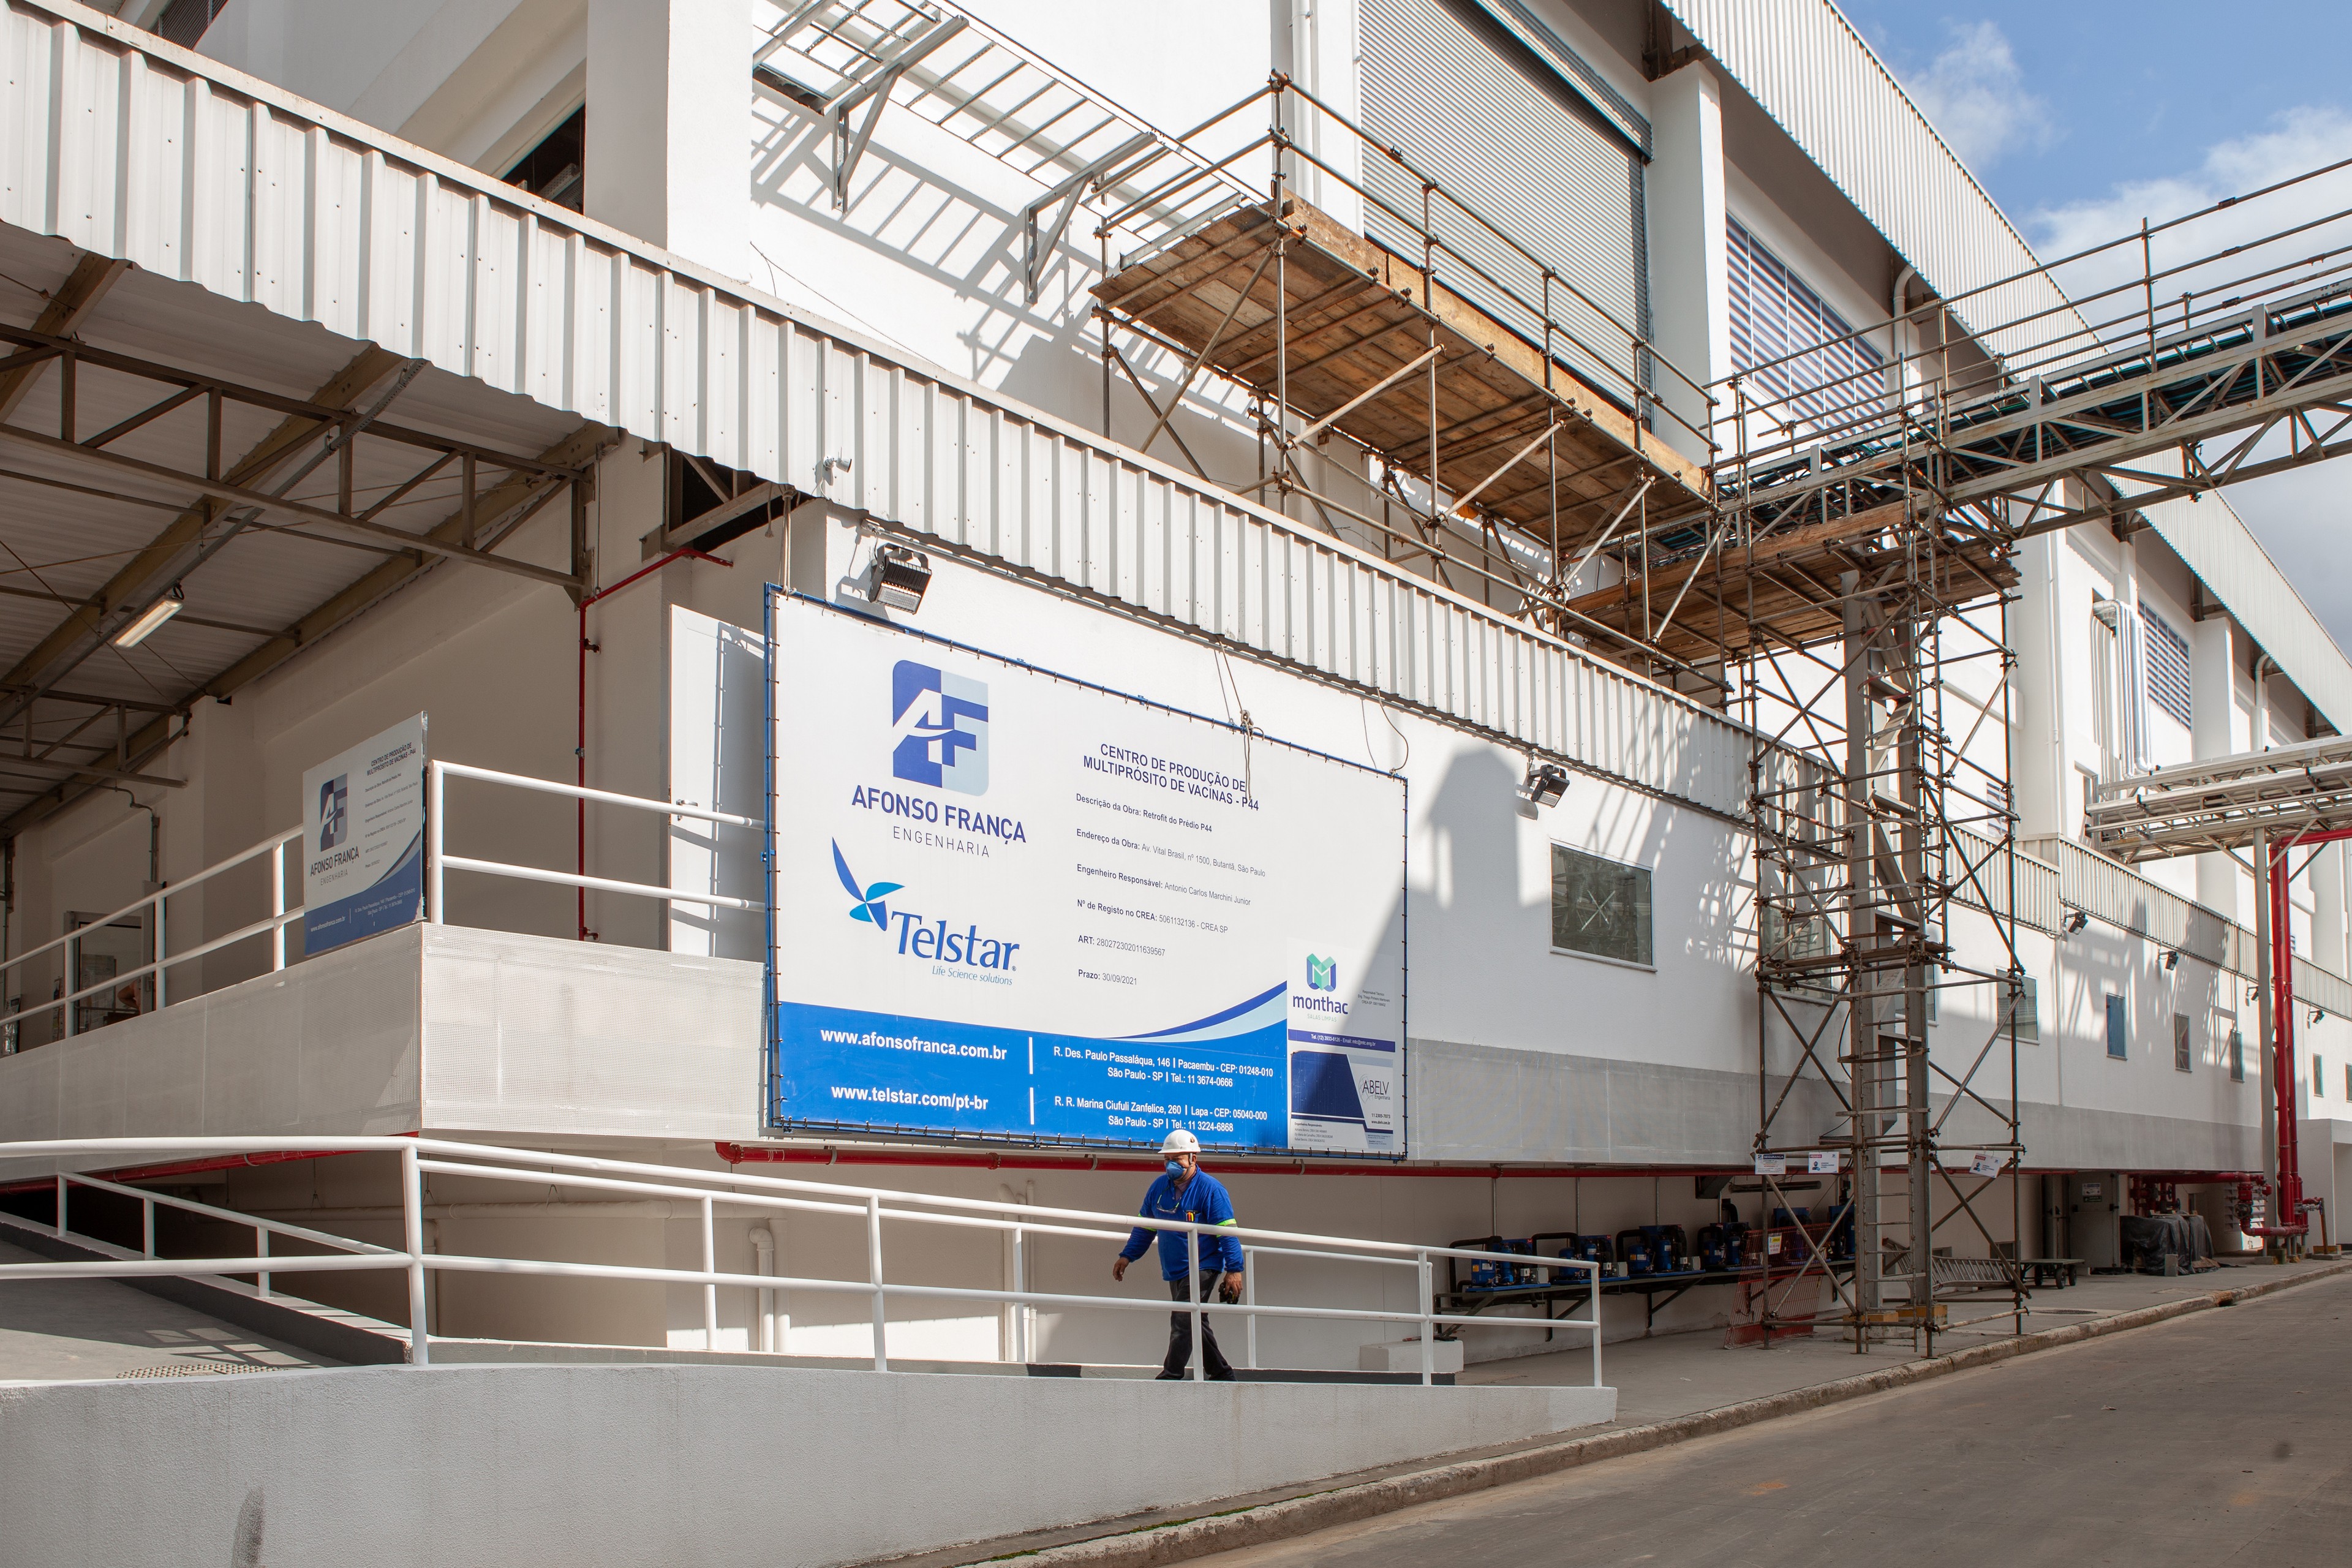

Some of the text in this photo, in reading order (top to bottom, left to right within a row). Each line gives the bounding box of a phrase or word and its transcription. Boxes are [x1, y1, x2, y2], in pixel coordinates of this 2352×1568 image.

[1084, 755, 1167, 788] MULTIPRÓSITO
[1170, 778, 1185, 792] DE
[1188, 783, 1233, 804] VACINAS
[1242, 797, 1259, 811] P44
[1101, 744, 1246, 792] CENTRO DE PRODUÇÃO DE
[852, 785, 1027, 845] AFONSO FRANÇA
[1077, 793, 1110, 809] Descrição
[1113, 802, 1121, 811] da
[1123, 805, 1141, 816] Obra:
[1144, 810, 1167, 823] Retrofit
[1179, 818, 1199, 830] Prédio
[1201, 824, 1212, 832] P44
[894, 826, 989, 858] ENGENHARIA
[1077, 829, 1110, 844] Endereço
[1112, 837, 1120, 845] da
[1121, 839, 1140, 850] Obra:
[1142, 844, 1151, 853] Av.
[1153, 846, 1166, 856] Vital
[1168, 850, 1186, 861] Brasil,
[1196, 856, 1211, 866] 1500,
[1213, 859, 1236, 872] Butantã,
[1238, 864, 1248, 873] São
[1250, 867, 1265, 877] Paulo
[311, 856, 333, 876] AFONSO
[334, 846, 359, 867] FRANÇA
[321, 869, 348, 886] ENGENHARIA
[1077, 864, 1250, 905] Engenheiro Responsável: Antonio Carlos Marchini Junior
[1088, 900, 1096, 910] de
[1098, 903, 1123, 915] Registo
[1136, 910, 1157, 921] CREA:
[1159, 914, 1195, 928] 5061132136
[1200, 922, 1218, 932] CREA
[1219, 925, 1227, 933] SP
[1079, 935, 1165, 956] ART: 280272302011639567
[932, 965, 1012, 986] Life Science solutions
[1079, 969, 1137, 986] Prazo: 30/09/2021
[1293, 995, 1348, 1014] monthac
[821, 1030, 1006, 1060] www.afonsofranca.com.br
[1054, 1047, 1062, 1056] R.
[1065, 1047, 1083, 1058] Des.
[1085, 1049, 1107, 1061] Paulo
[1110, 1052, 1155, 1067] Passaláqua,
[1158, 1057, 1170, 1067] 146
[1178, 1060, 1214, 1071] Pacaembu
[1221, 1063, 1237, 1074] CEP:
[1239, 1065, 1273, 1077] 01248-010
[1108, 1067, 1122, 1077] São
[1125, 1069, 1145, 1079] Paulo
[1153, 1071, 1163, 1081] SP
[1171, 1073, 1185, 1083] Tel.:
[1188, 1074, 1194, 1084] 11
[1197, 1075, 1232, 1087] 3674-0666
[831, 1087, 988, 1110] www.telstar.com/pt-br
[1362, 1080, 1389, 1095] ABELV
[1055, 1096, 1064, 1106] R.
[1066, 1097, 1074, 1107] R.
[1077, 1098, 1103, 1109] Marina
[1106, 1100, 1129, 1111] Ciufuli
[1131, 1102, 1166, 1115] Zanfelice,
[1169, 1105, 1181, 1114] 260
[1191, 1107, 1208, 1118] Lapa
[1214, 1108, 1231, 1118] CEP:
[1233, 1109, 1267, 1120] 05040-000
[1109, 1116, 1123, 1126] São
[1126, 1117, 1146, 1127] Paulo
[1153, 1118, 1163, 1128] SP
[1171, 1120, 1186, 1129] Tel.:
[1188, 1121, 1195, 1129] 11
[1197, 1121, 1233, 1132] 3224-6868
